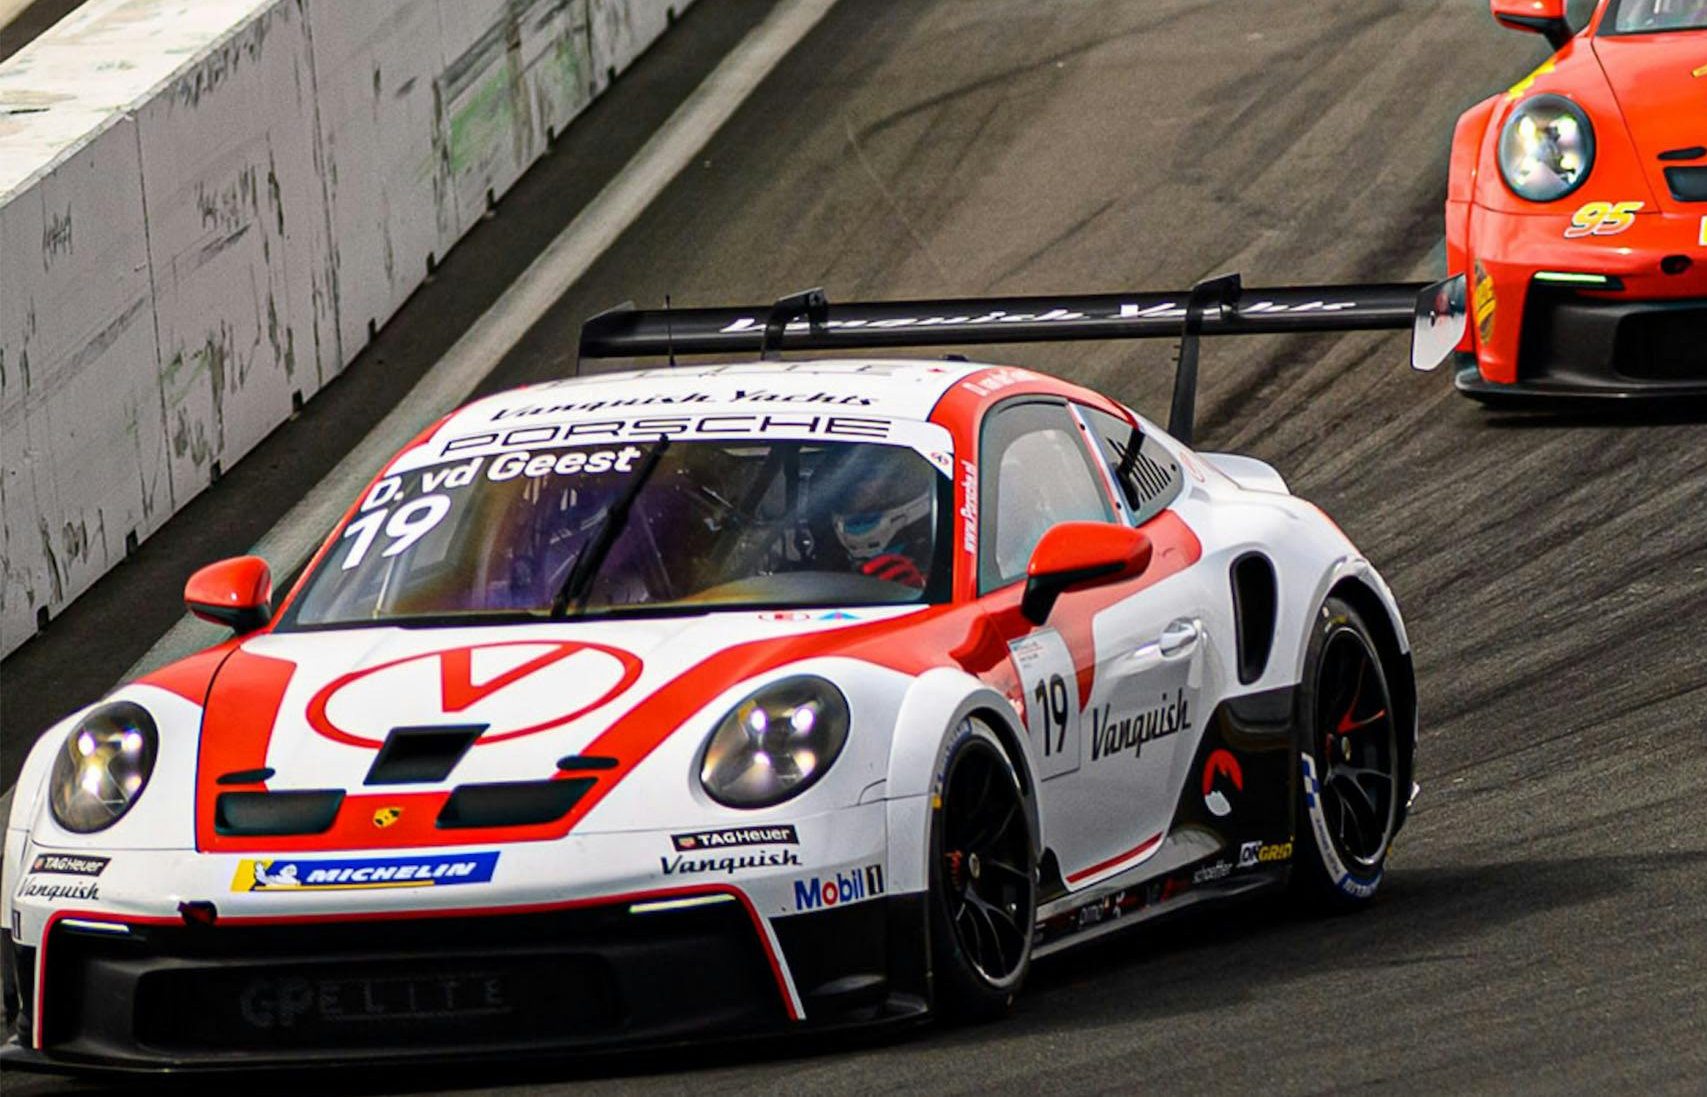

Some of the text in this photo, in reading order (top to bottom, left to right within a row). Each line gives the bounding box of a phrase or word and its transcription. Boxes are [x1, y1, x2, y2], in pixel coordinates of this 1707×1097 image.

[1565, 202, 1645, 239] 95
[490, 389, 880, 421] Vanquish Yachts
[440, 416, 892, 457] PORSCHE
[361, 445, 641, 512] D. vd Geest
[340, 495, 451, 571] 19
[1035, 673, 1068, 757] 19
[1091, 687, 1192, 761] Vanquish
[700, 828, 790, 846] TAGHeuer
[43, 856, 105, 873] TAGHeuer
[306, 861, 477, 884] MICHELIN
[660, 849, 802, 875] Vanquish
[794, 869, 863, 910] Mobil
[239, 979, 318, 1028] GP
